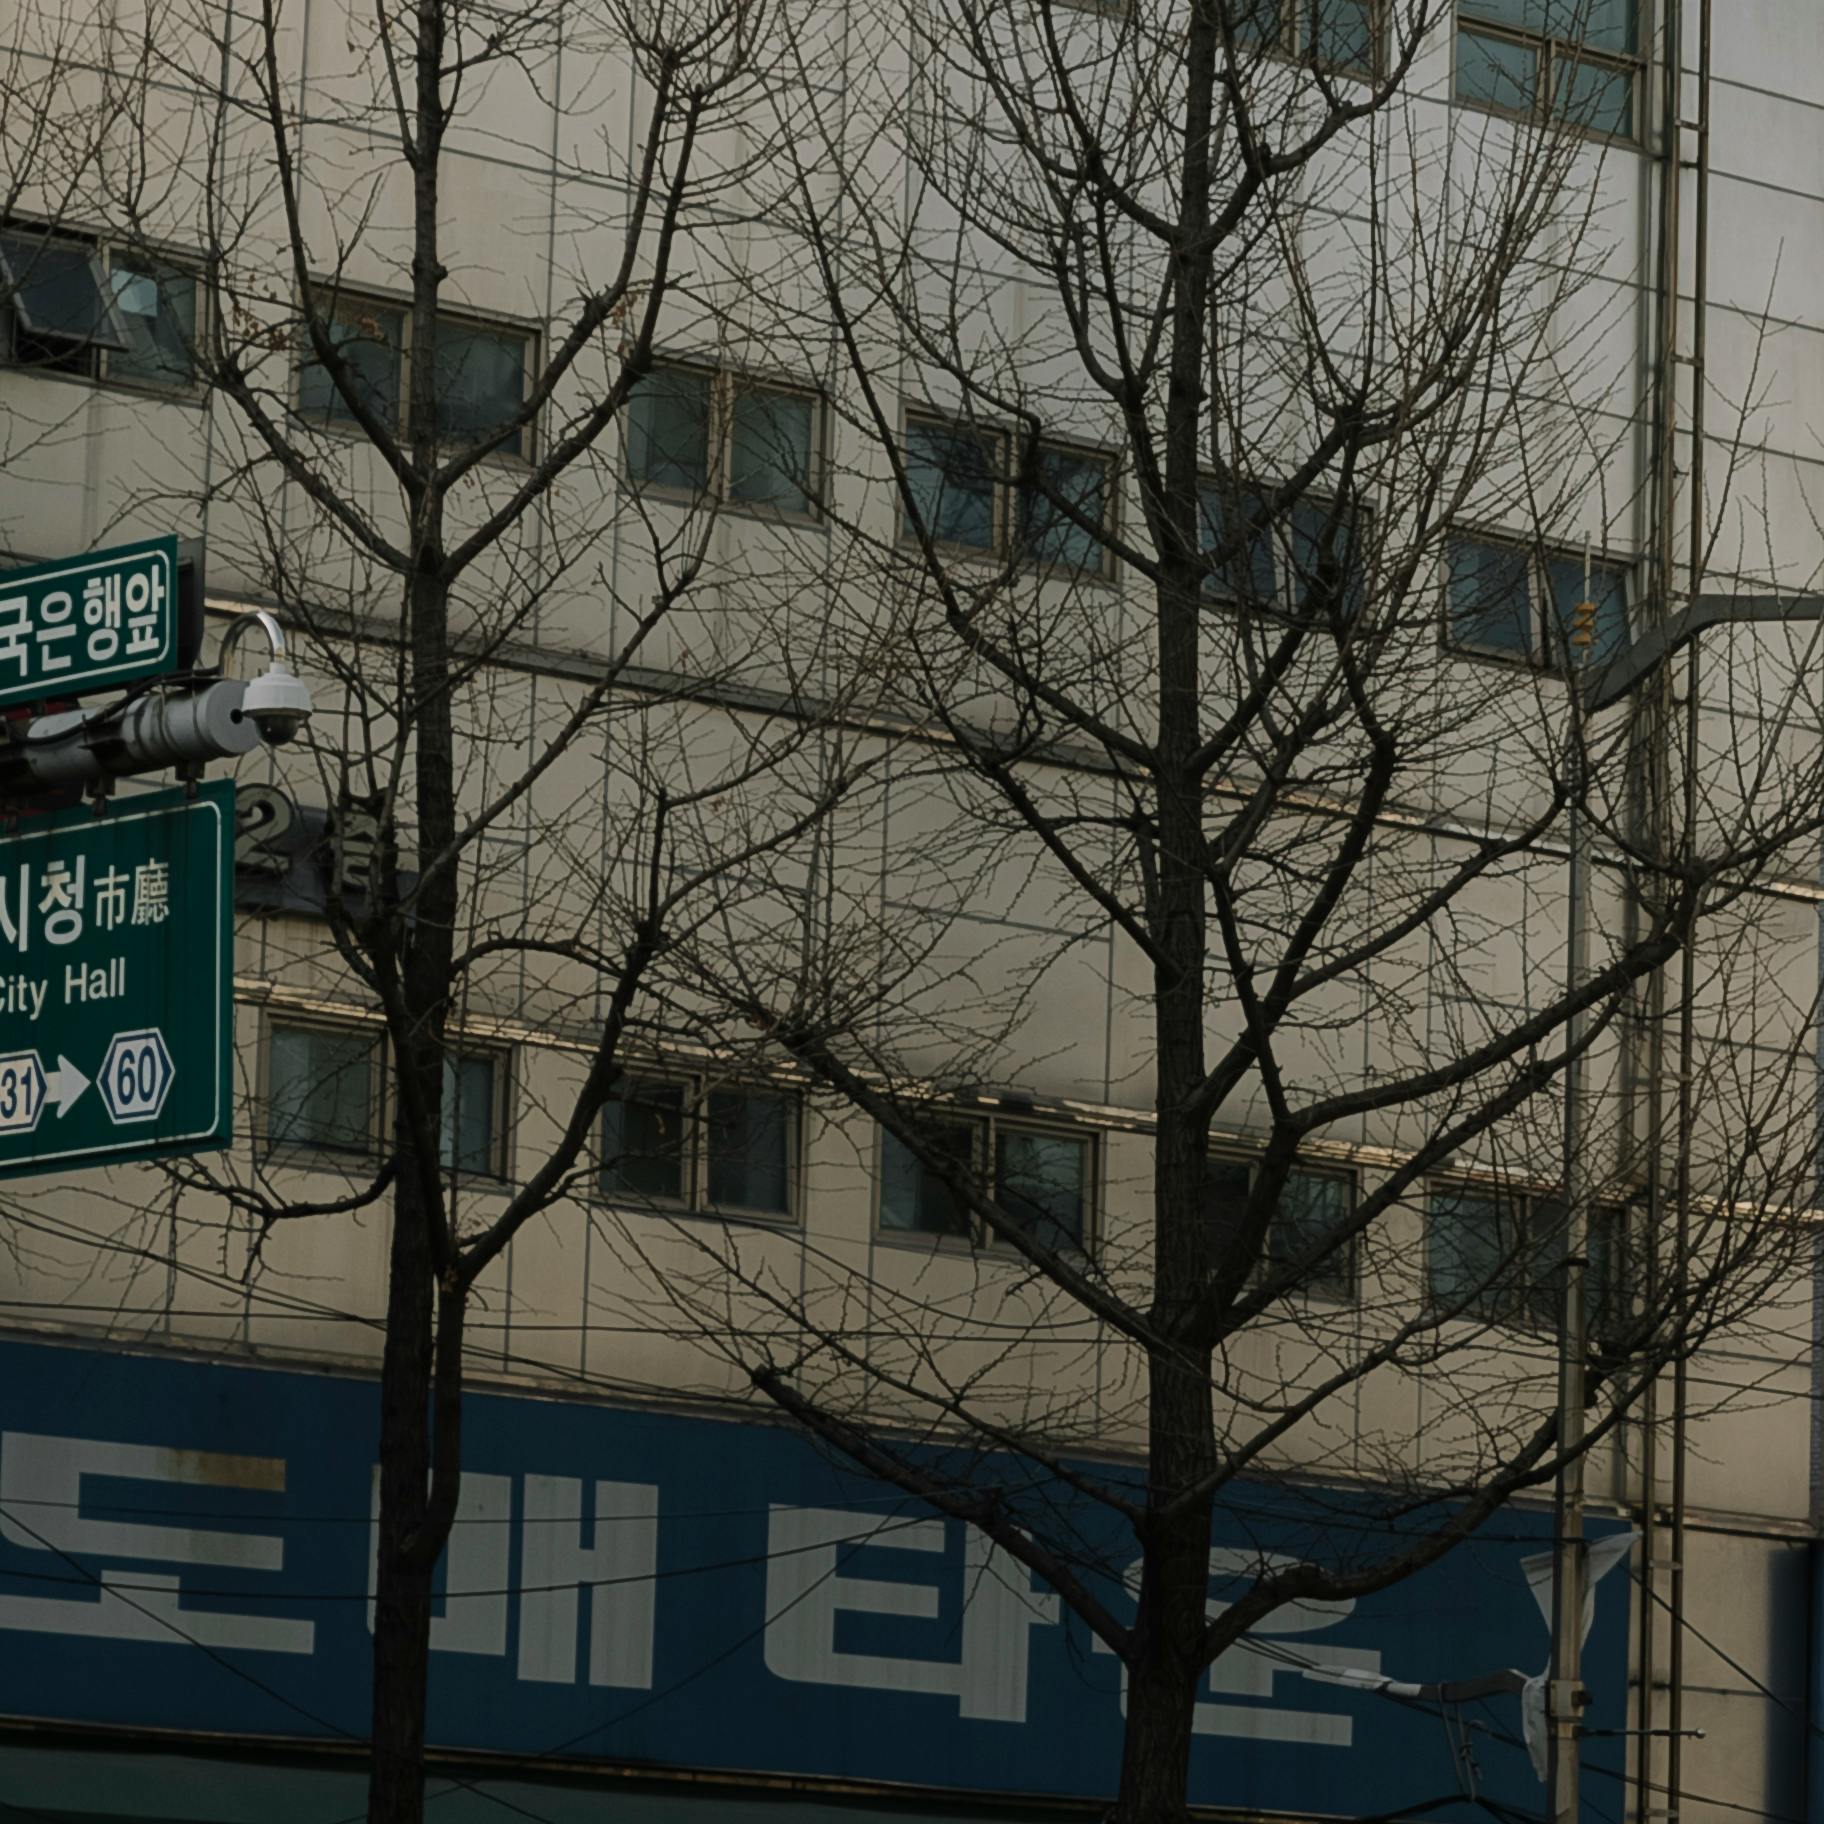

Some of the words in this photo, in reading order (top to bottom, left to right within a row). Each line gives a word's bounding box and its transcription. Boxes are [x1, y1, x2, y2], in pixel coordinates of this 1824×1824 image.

[0, 564, 165, 677] 국은행앞
[93, 857, 170, 931] 市廳
[65, 956, 126, 1004] Hall
[117, 1046, 156, 1106] 60
